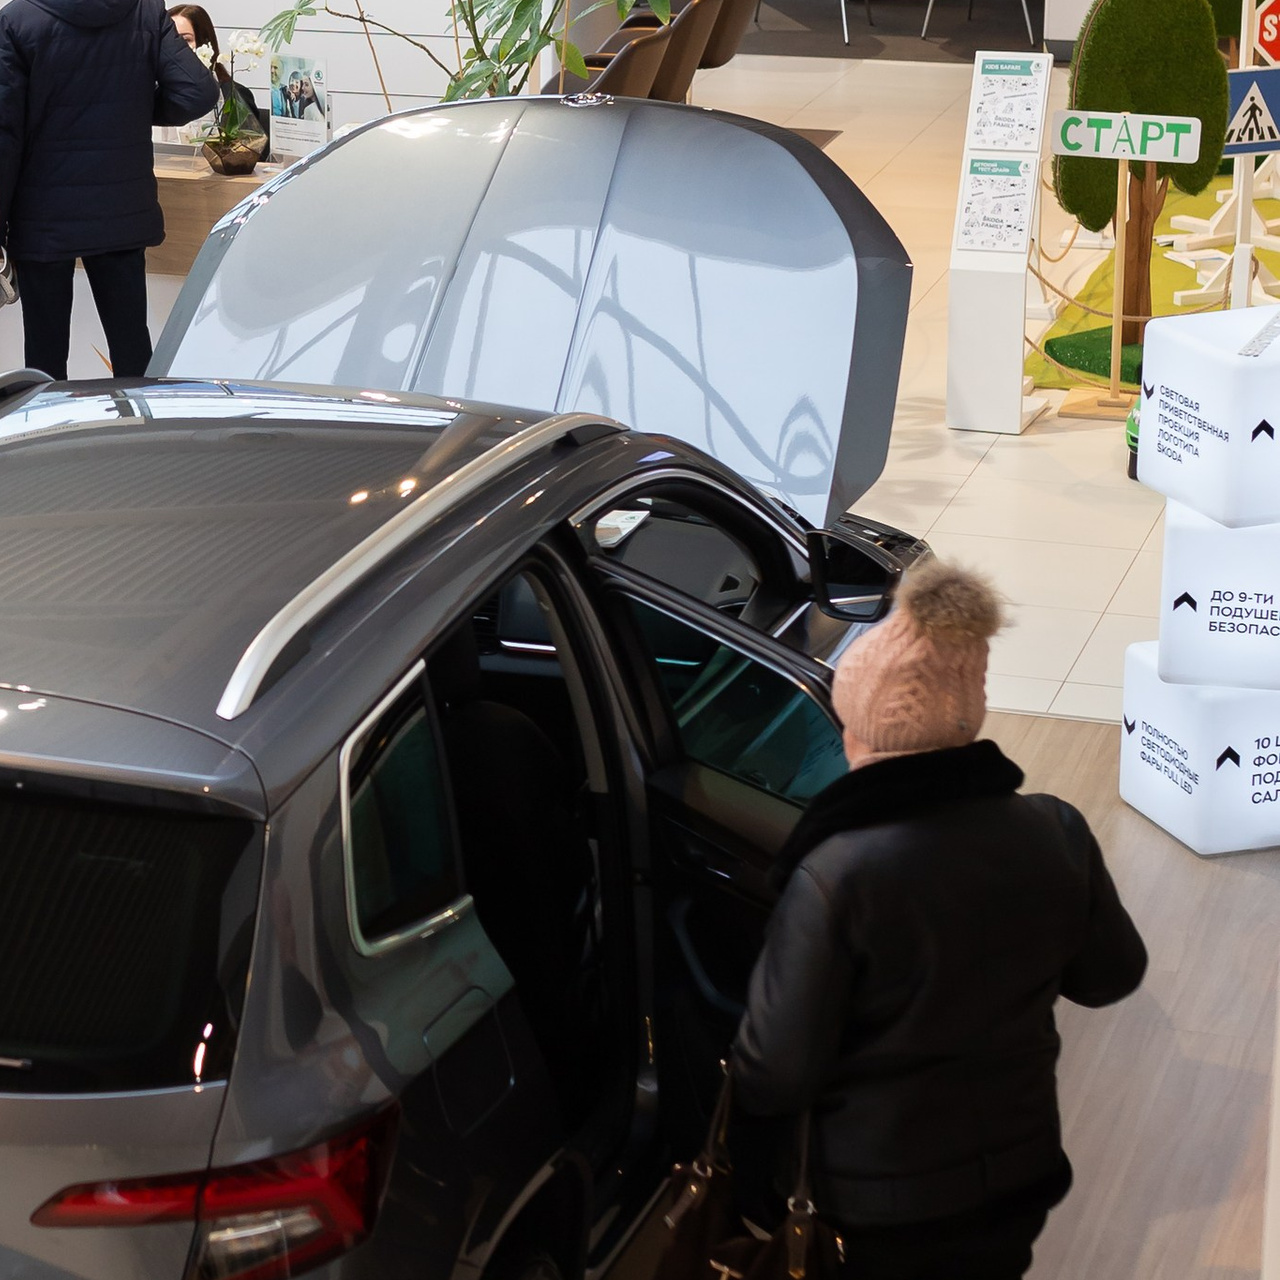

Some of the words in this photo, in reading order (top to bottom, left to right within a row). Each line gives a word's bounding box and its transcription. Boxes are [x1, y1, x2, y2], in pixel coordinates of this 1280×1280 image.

[1059, 116, 1192, 157] СТАРТ
[981, 222, 1003, 230] FAMILY
[1159, 385, 1200, 412] СВЕТОВАЯ
[1158, 399, 1230, 442] ПРИВЕТСТВЕННАЯ
[1158, 414, 1200, 442] ПРОЕКЦИЯ
[1157, 428, 1200, 457] ЛОГОТИПА
[1157, 442, 1183, 464] ŠKODA
[1210, 590, 1234, 603] ДО
[1238, 591, 1274, 605] 9-ТИ
[1210, 605, 1280, 621] ПОДУШЕ
[1141, 720, 1189, 760] ПОЛНОСТЬЮ
[1254, 737, 1271, 750] 10
[1140, 751, 1163, 773] ФАРЫ
[1163, 764, 1179, 785] FULL
[1180, 778, 1193, 795] LED
[1141, 735, 1200, 785] СВЕТОДИОДНЫЕ
[1253, 753, 1280, 767] ФО
